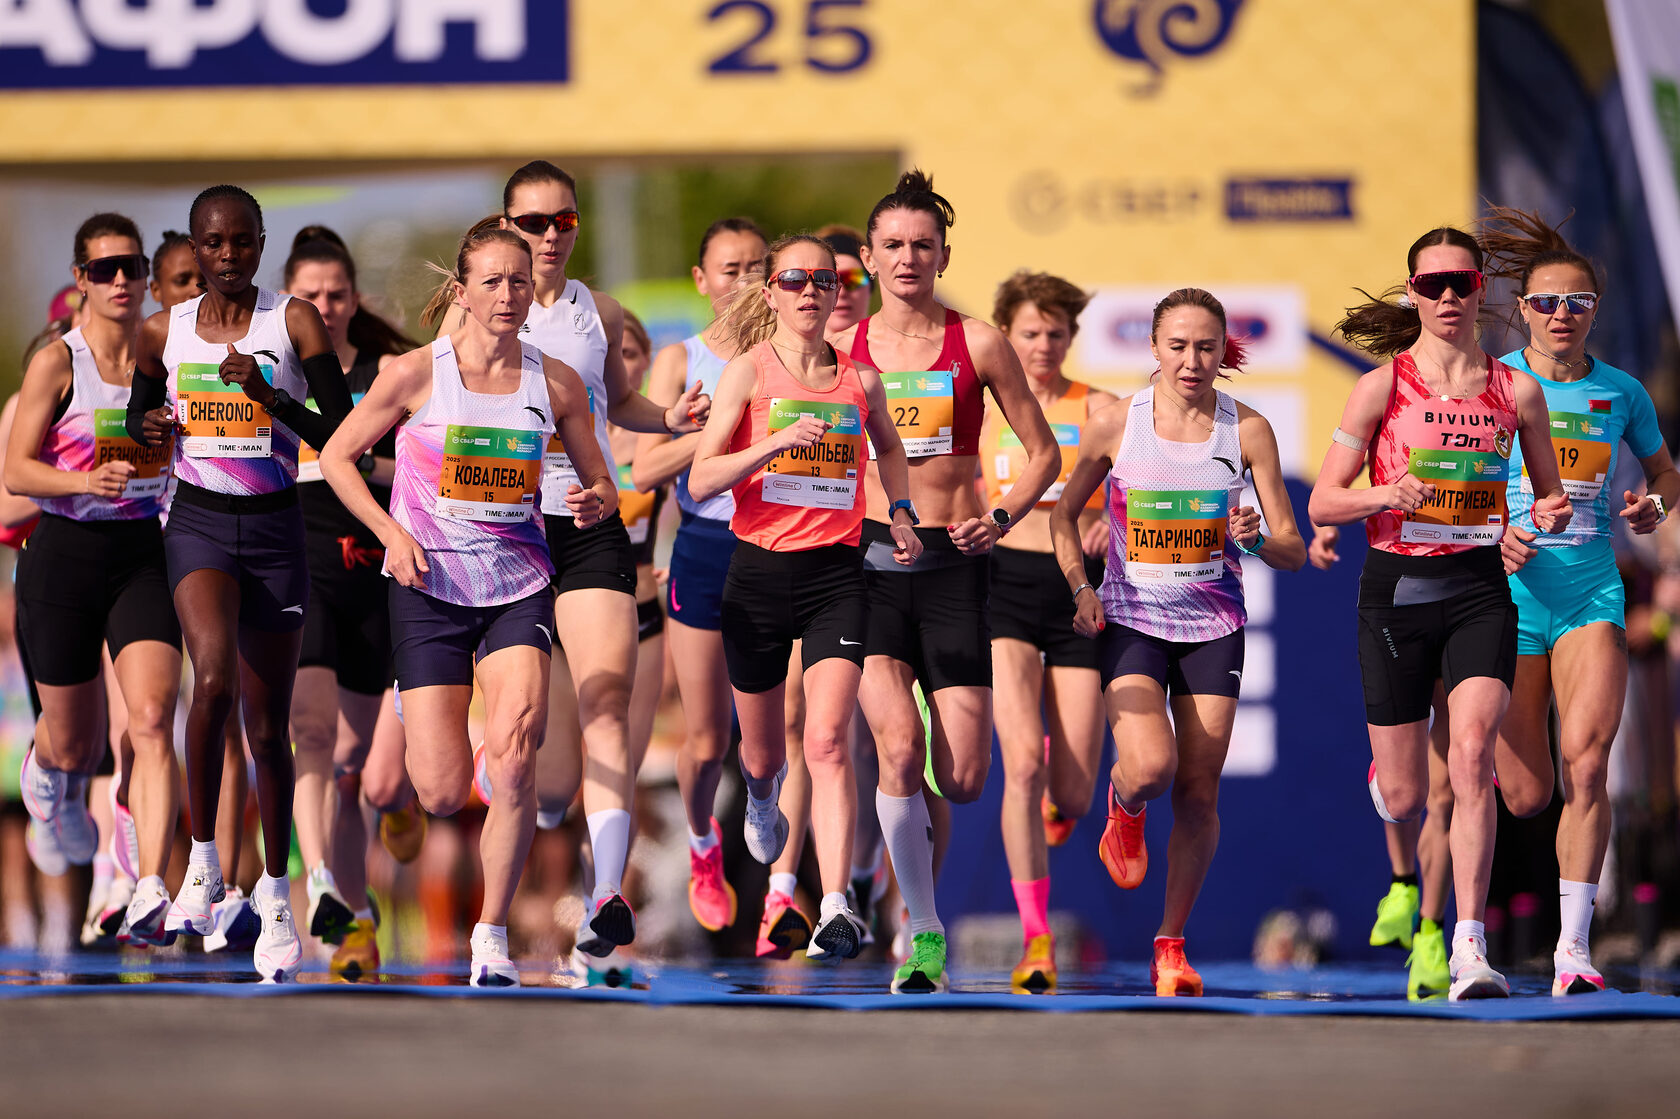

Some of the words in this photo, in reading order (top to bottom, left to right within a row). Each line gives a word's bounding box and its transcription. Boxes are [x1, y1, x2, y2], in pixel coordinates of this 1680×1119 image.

[707, 0, 872, 74] 25
[190, 401, 253, 422] CHERONO
[894, 407, 920, 426] 22
[1425, 412, 1496, 427] BIVIUM
[215, 426, 225, 436] 16
[100, 446, 170, 464] РЕЗНИЧЕНКО
[776, 442, 855, 464] ОКОПЬЕВА
[1560, 447, 1579, 468] 19
[454, 465, 525, 489] КОВАЛЕВА
[811, 466, 820, 477] 13
[484, 492, 494, 502] 15
[1419, 489, 1496, 509] МИТРИЕВА
[1452, 515, 1460, 525] 11
[1133, 528, 1219, 549] ТАТАРИНОВА
[1171, 553, 1182, 564] 12
[1382, 627, 1398, 658] BIVIUM
